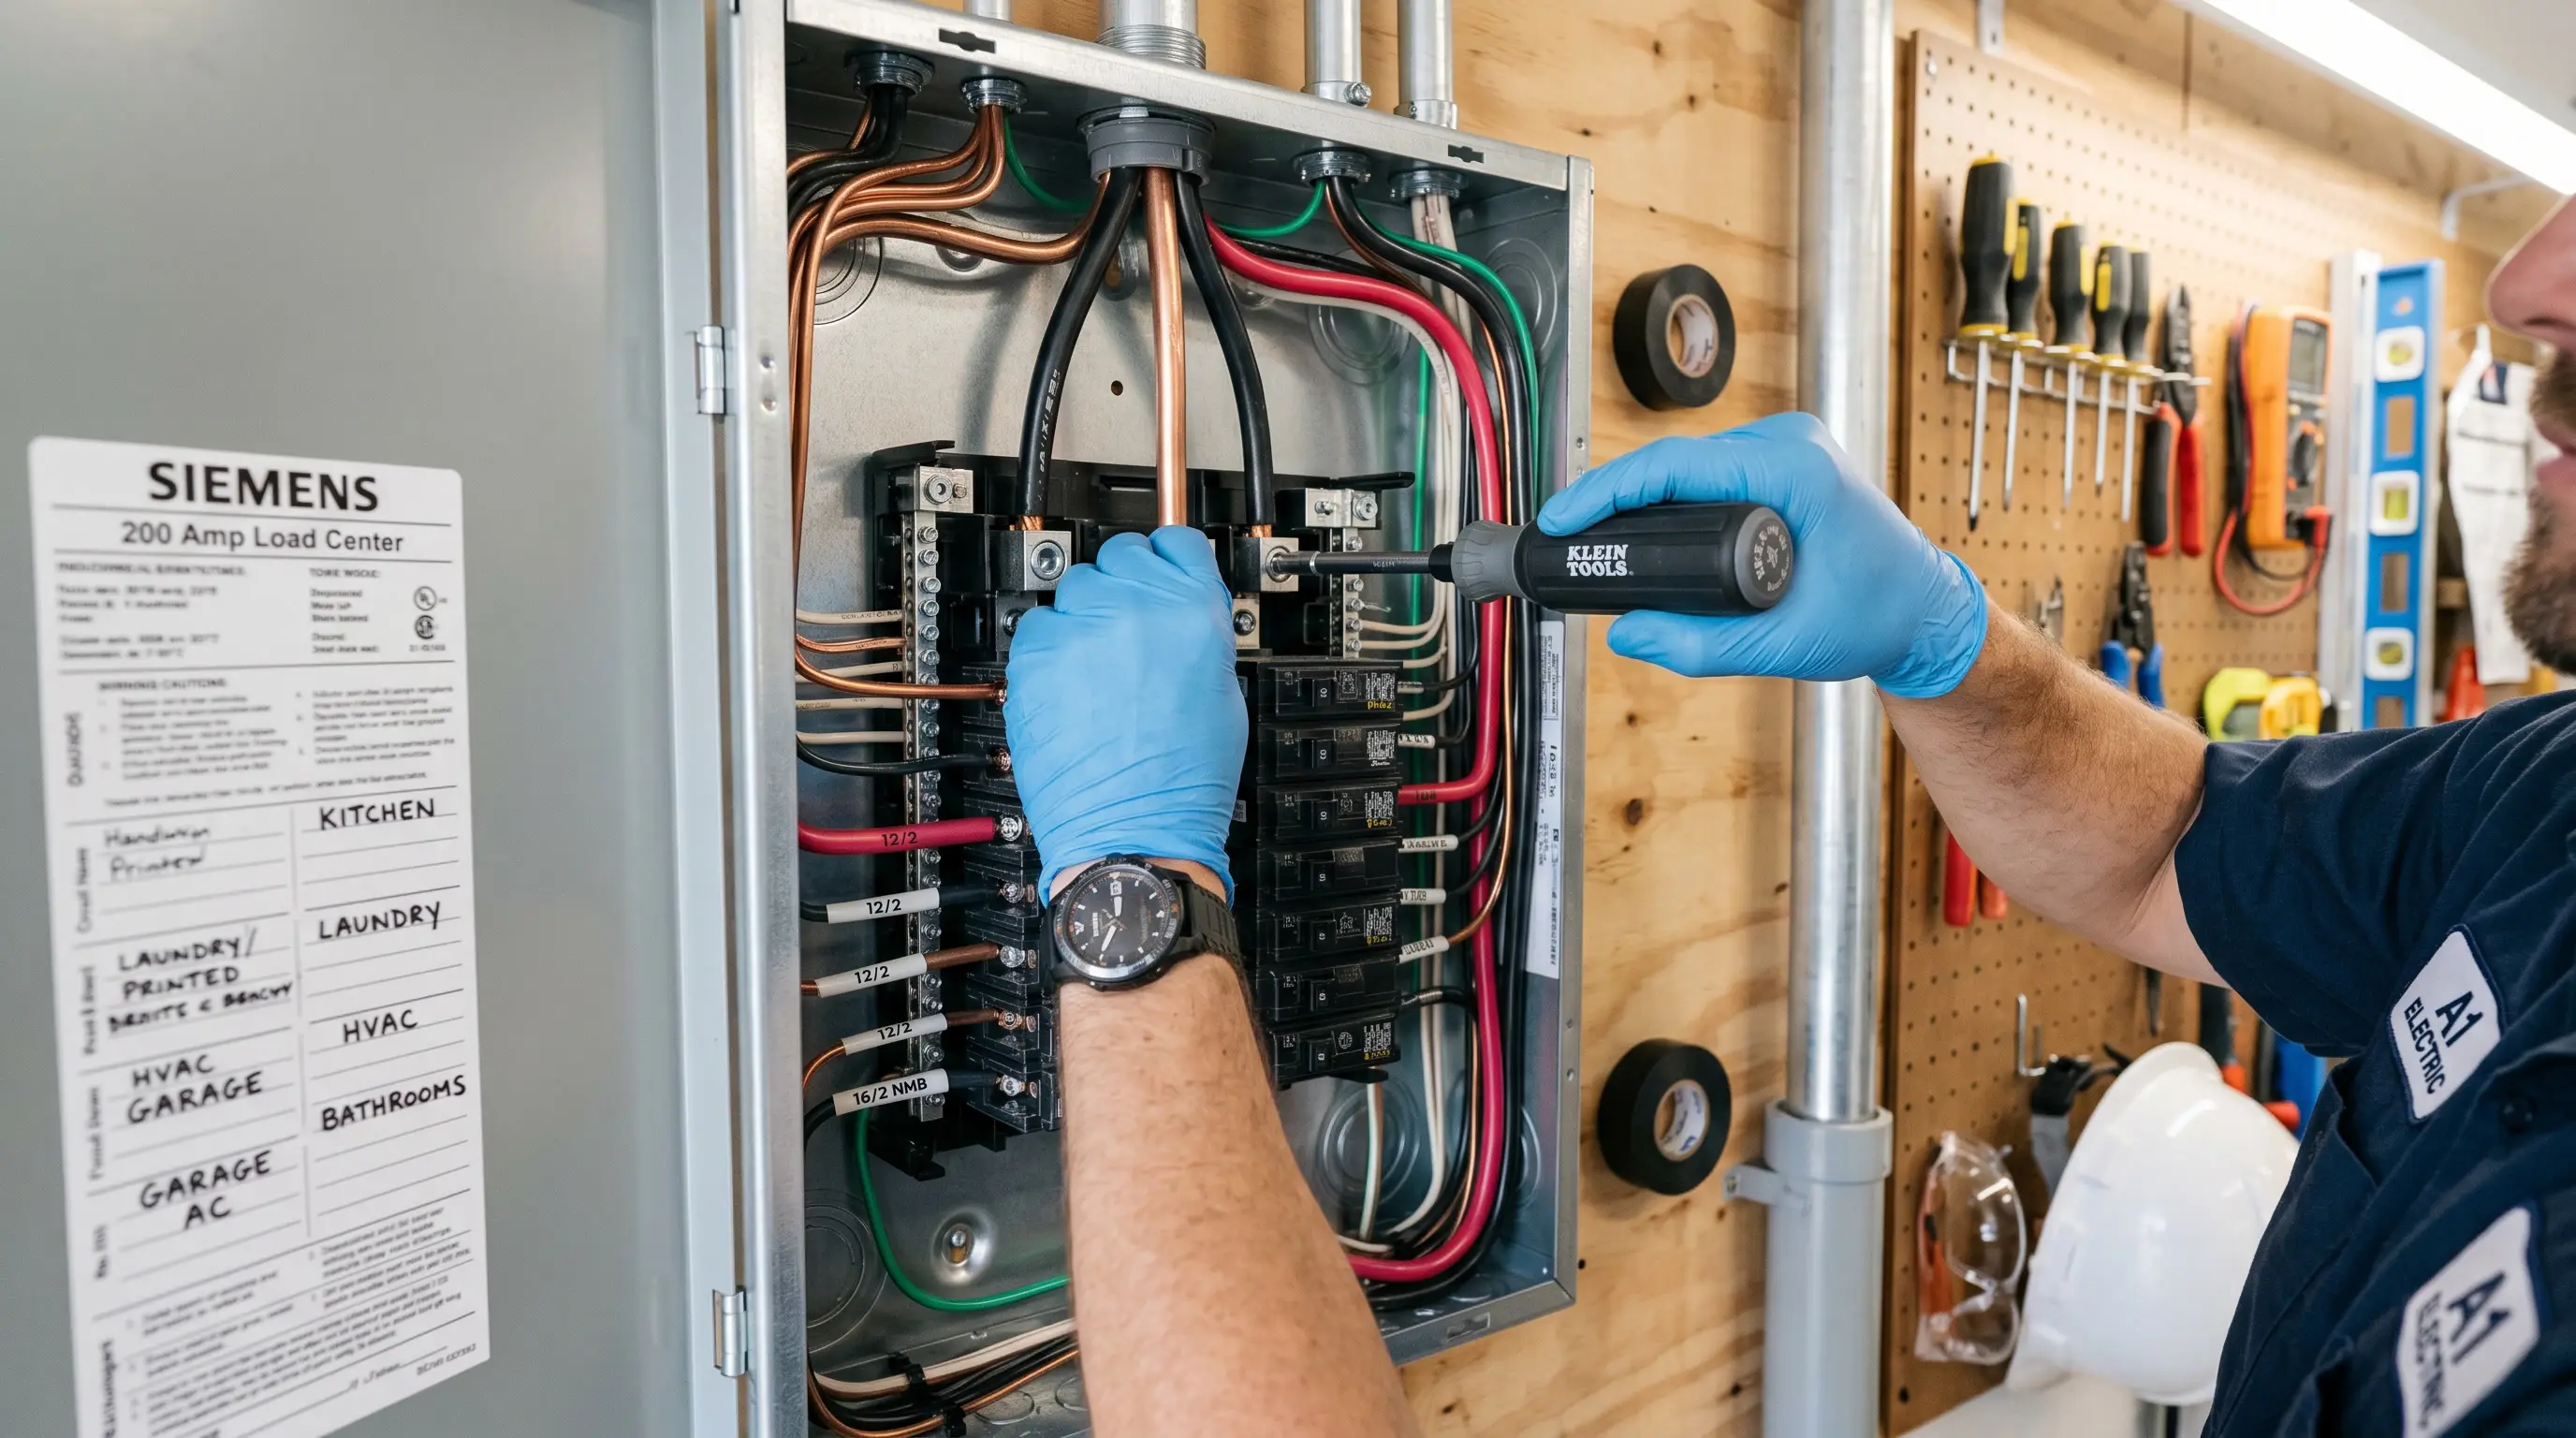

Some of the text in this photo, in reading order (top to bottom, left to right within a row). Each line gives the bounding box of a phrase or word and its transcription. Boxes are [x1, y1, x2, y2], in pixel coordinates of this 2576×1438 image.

[148, 461, 380, 513] SIEMENS
[121, 521, 404, 552] 200 Amp Load Center
[1567, 544, 1629, 562] KLEIN
[1567, 560, 1628, 577] TOOLS
[319, 798, 436, 831] KITCHEN
[881, 830, 919, 847] 12/2
[317, 901, 442, 940] LAUNDRY
[866, 898, 902, 916] 12/2
[122, 965, 241, 1001] PRINTED
[854, 964, 891, 985] 12/2
[343, 1008, 419, 1044] HVAC
[876, 1021, 914, 1041] 12/2
[2435, 990, 2484, 1048] A1
[2404, 996, 2446, 1094] ELECTRIC
[132, 1053, 215, 1088] HVAC
[126, 1070, 264, 1125] GARAGE
[320, 1074, 467, 1133] BATHROOMS
[852, 1077, 929, 1107] 16/2 NMB
[139, 1149, 272, 1210] GARAGE
[183, 1195, 233, 1231] AC
[2447, 1270, 2511, 1366] A1
